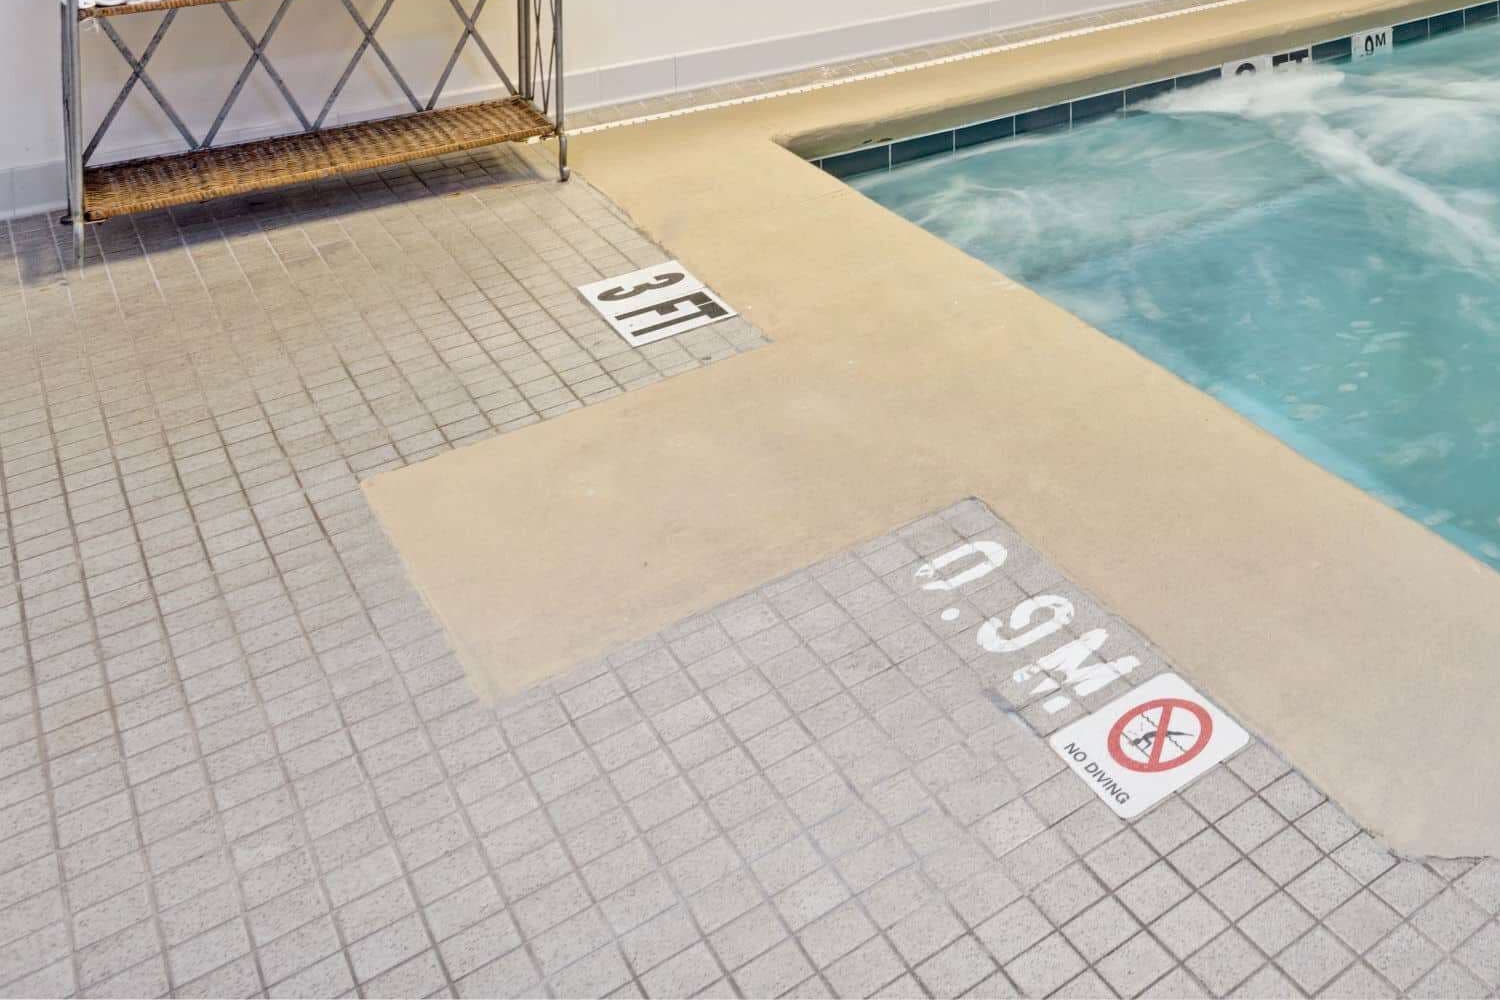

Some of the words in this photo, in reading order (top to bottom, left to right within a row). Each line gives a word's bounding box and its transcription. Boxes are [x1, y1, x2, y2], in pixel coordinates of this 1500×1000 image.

[597, 272, 686, 302] 3
[614, 291, 729, 338] FT
[1063, 742, 1088, 762] NO
[1084, 762, 1130, 805] DIVING
